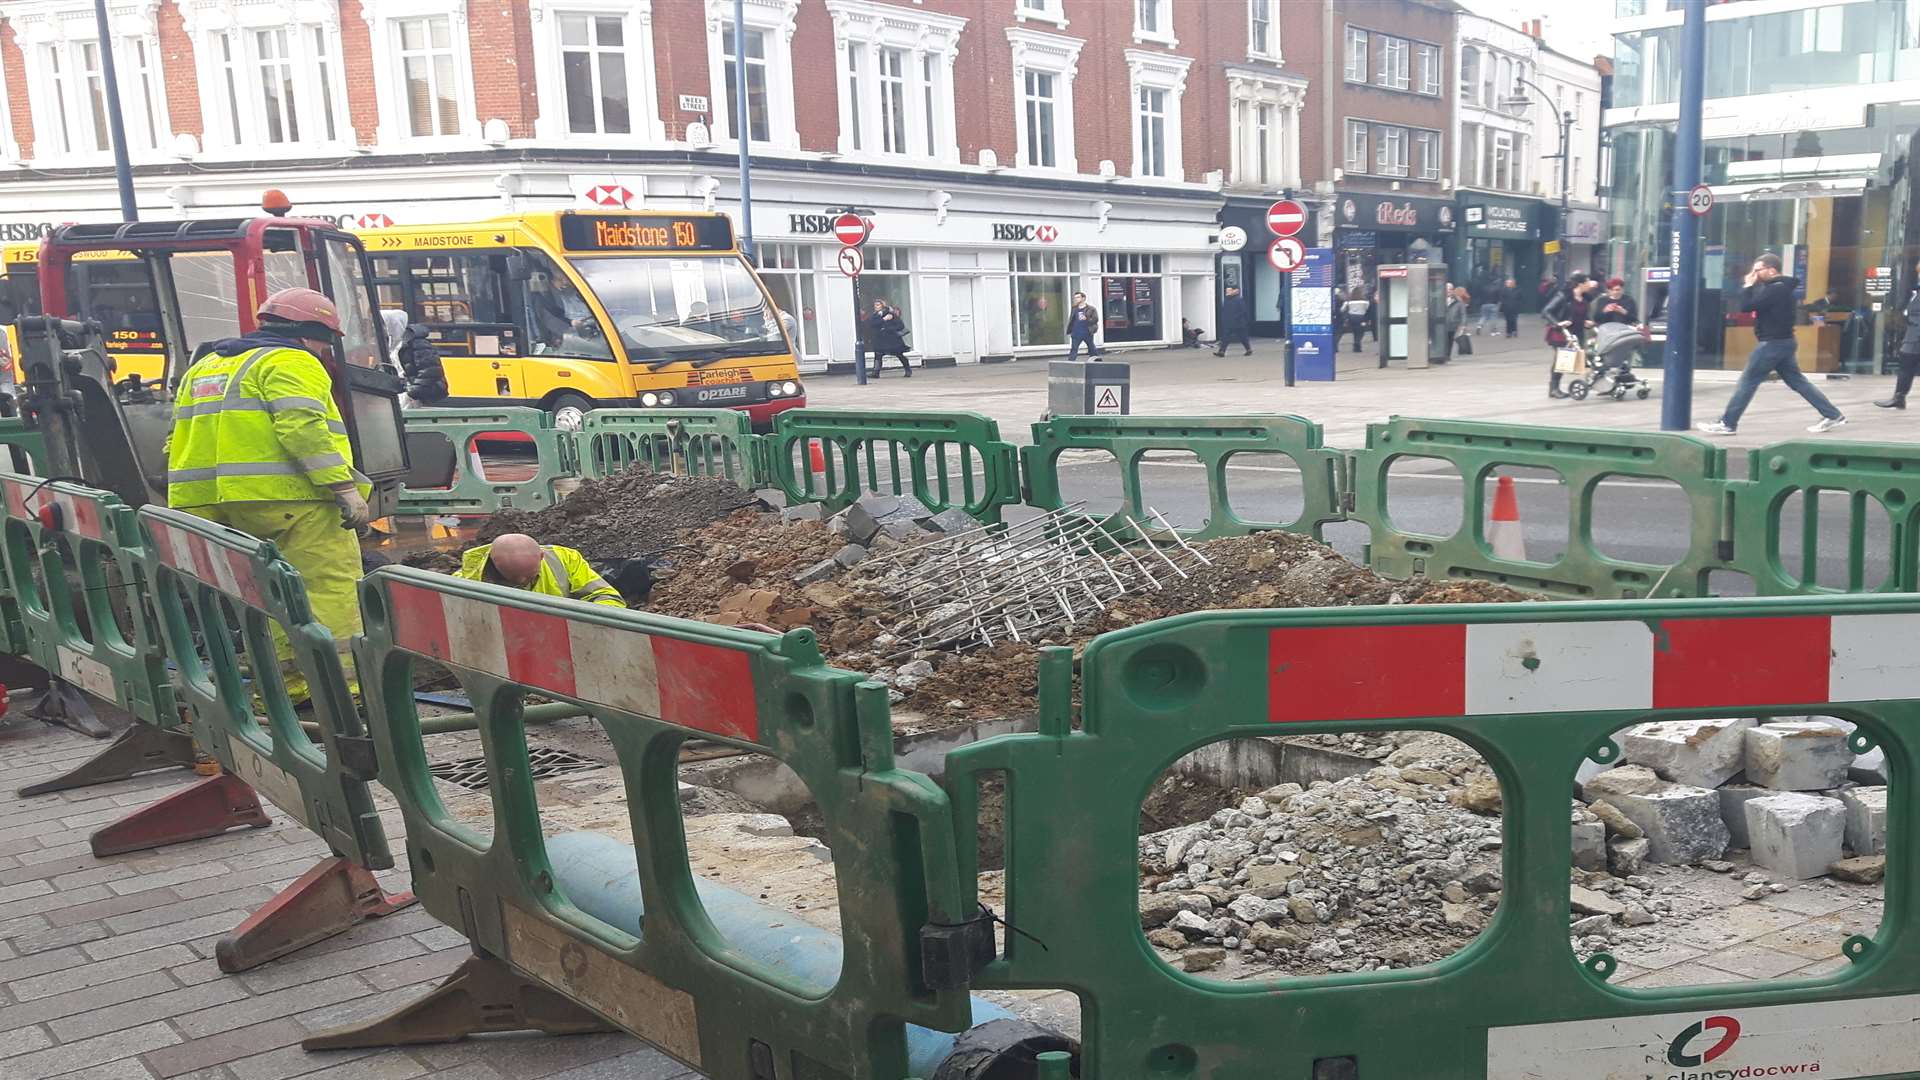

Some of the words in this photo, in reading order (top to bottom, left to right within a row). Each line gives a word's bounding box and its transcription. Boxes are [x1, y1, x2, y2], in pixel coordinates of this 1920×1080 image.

[1693, 194, 1711, 207] 20
[1487, 207, 1521, 219] MOUNTAIN
[595, 221, 668, 246] Maidstone
[672, 222, 696, 246] 150
[992, 223, 1036, 241] HSBC
[414, 236, 473, 246] MAIDSTONE
[112, 330, 138, 340] 150
[699, 367, 740, 384] Farleigh
[698, 386, 748, 401] OPTARE
